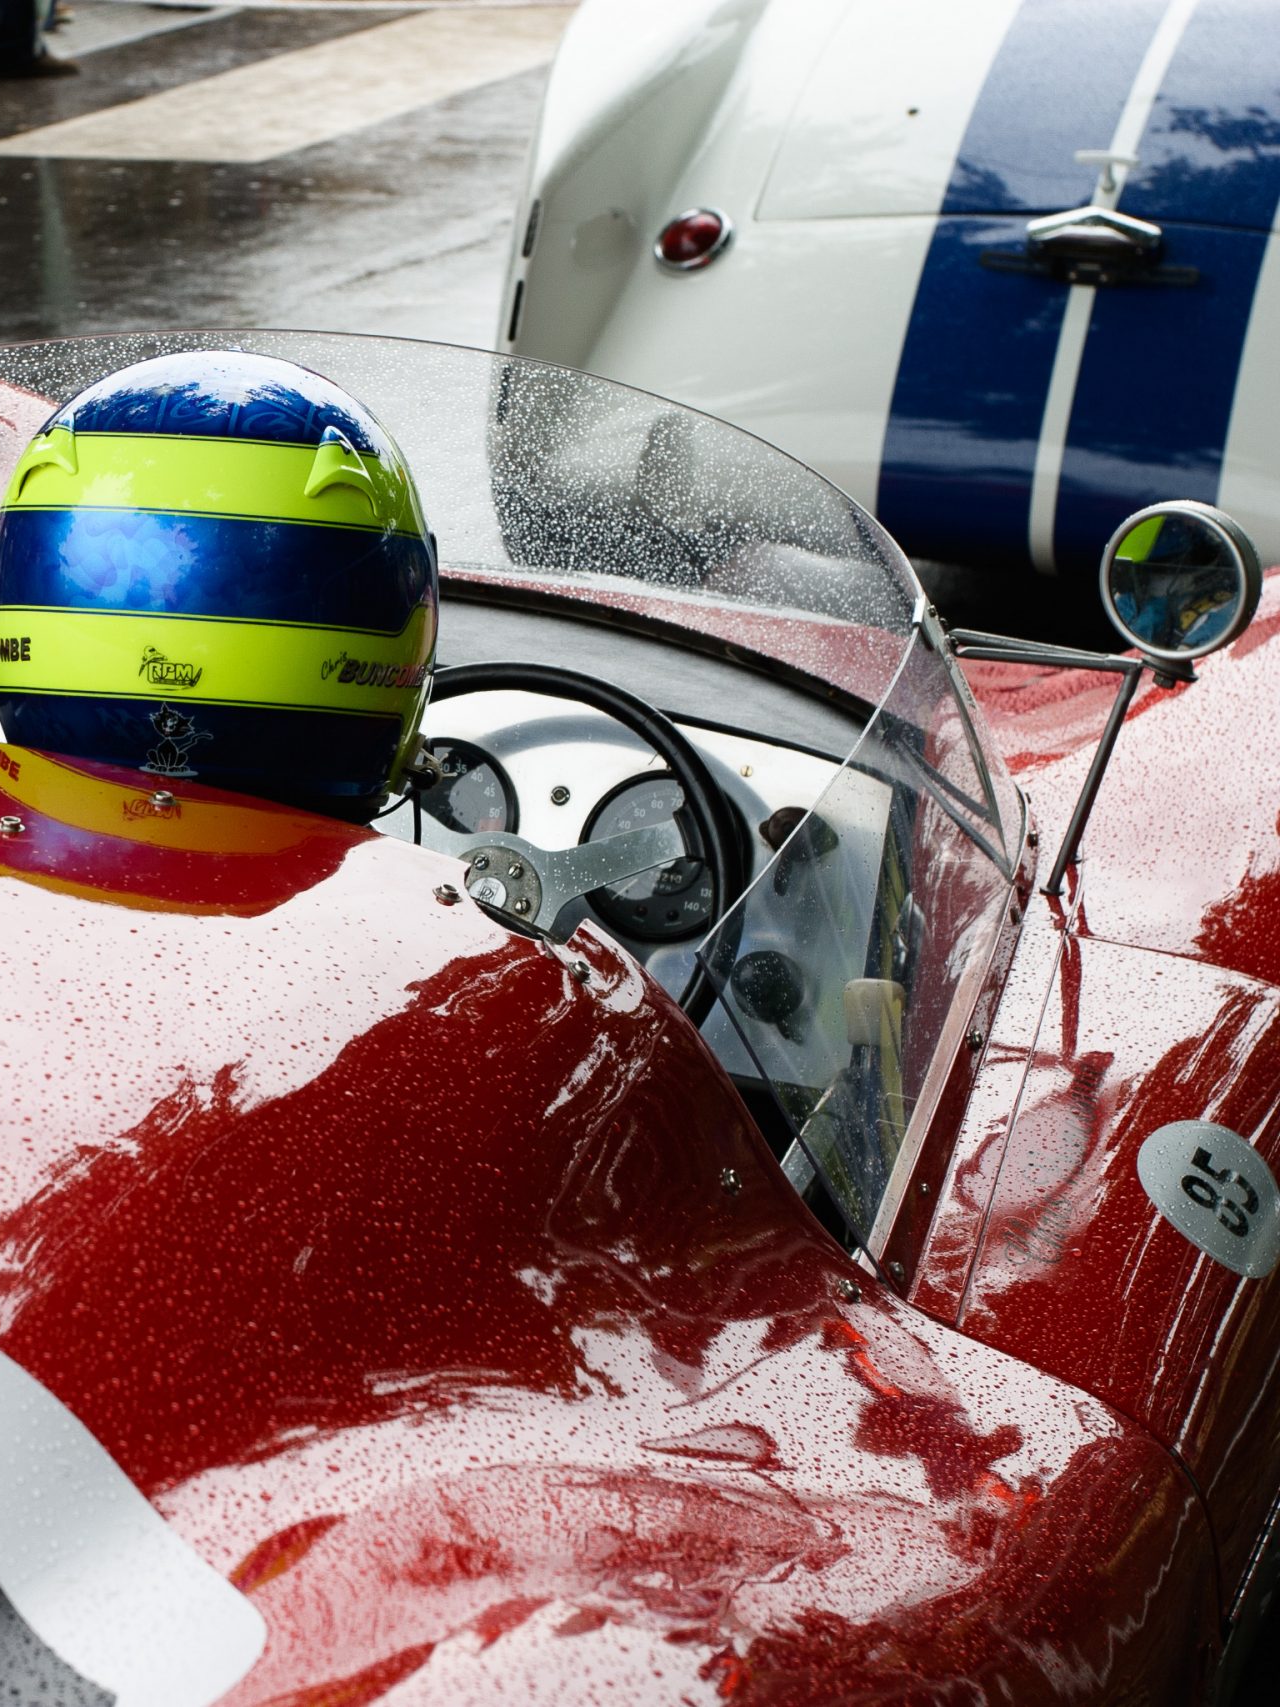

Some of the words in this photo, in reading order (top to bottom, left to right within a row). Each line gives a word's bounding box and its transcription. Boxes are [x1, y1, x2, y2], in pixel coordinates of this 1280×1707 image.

[147, 661, 193, 684] RPM
[455, 763, 467, 774] 35
[470, 772, 484, 783] 40
[483, 786, 496, 798] 45
[489, 807, 500, 818] 50
[633, 808, 646, 818] 50
[683, 900, 700, 911] 140
[1181, 1146, 1259, 1237] 85
